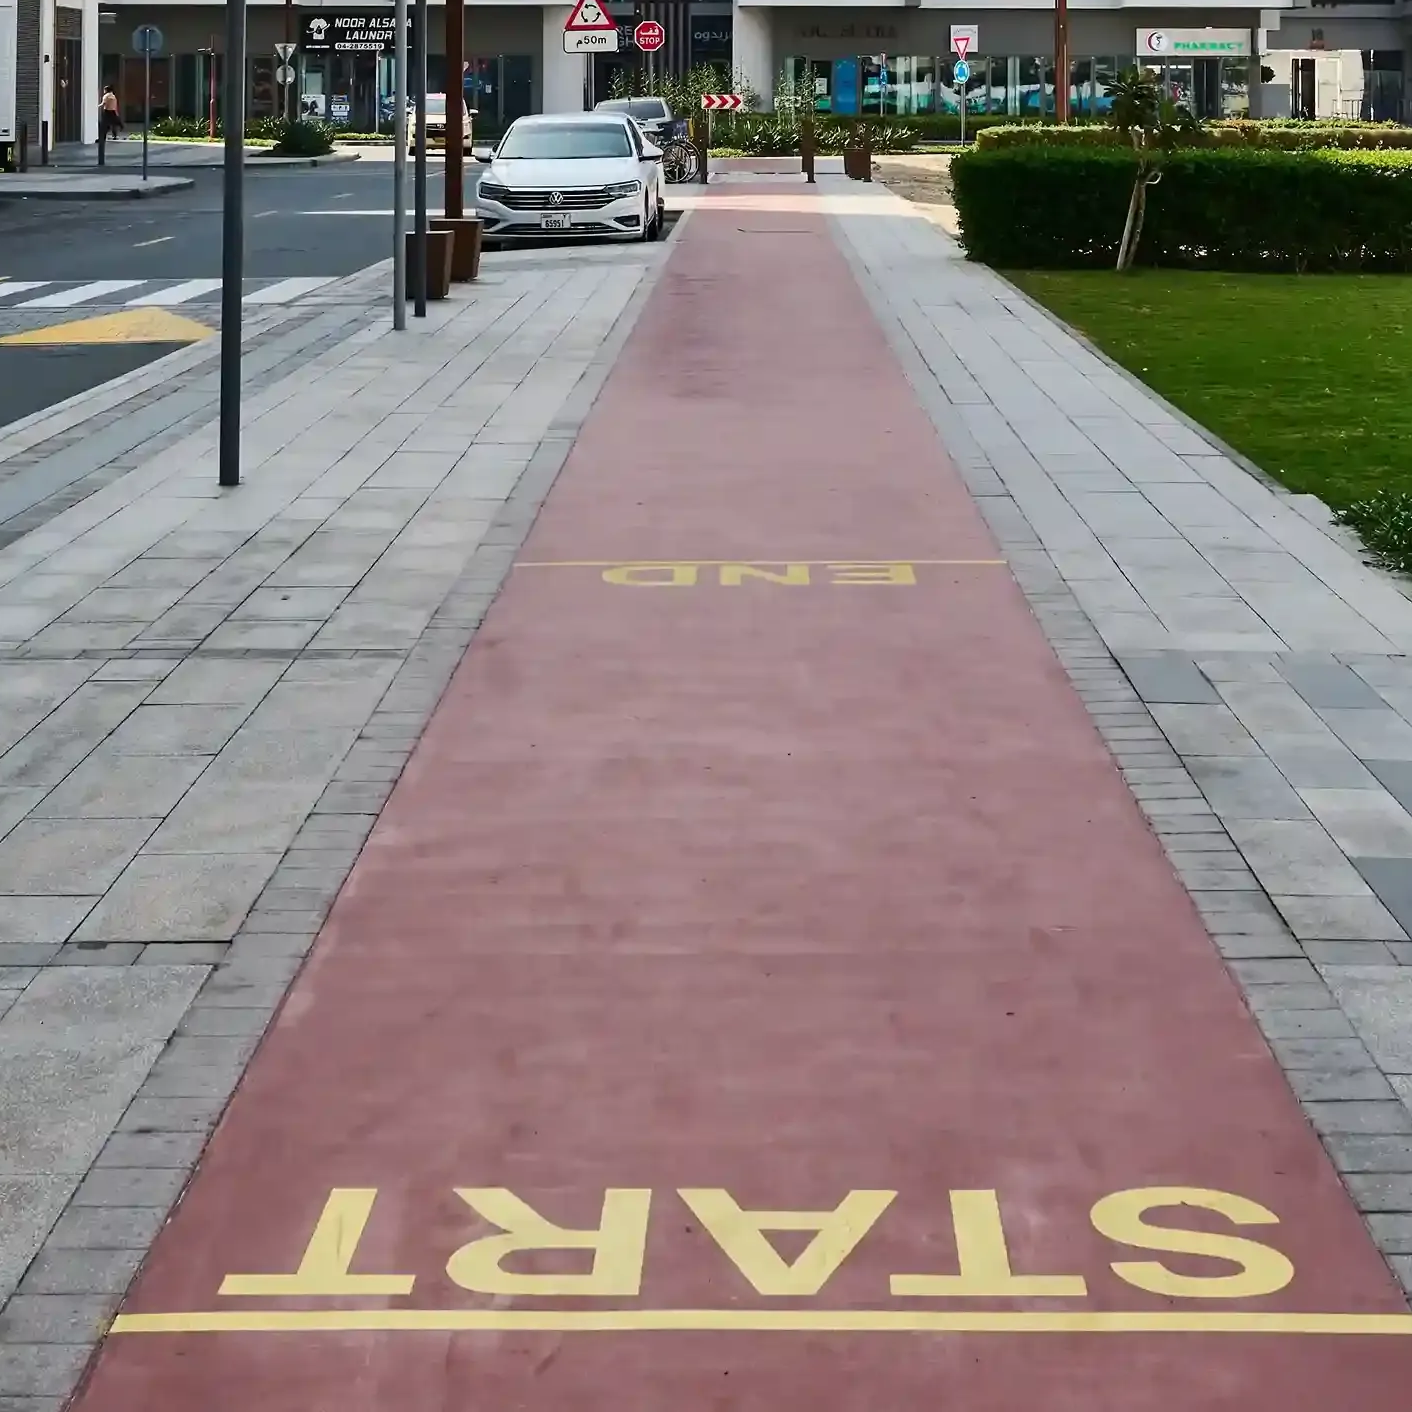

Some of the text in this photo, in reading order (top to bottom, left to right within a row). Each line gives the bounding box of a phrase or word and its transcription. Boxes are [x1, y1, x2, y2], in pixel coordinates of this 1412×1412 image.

[334, 18, 412, 28] NOOR ALSAA
[345, 31, 396, 40] LAUNDR
[639, 37, 660, 45] STOP
[602, 564, 917, 586] END
[216, 1185, 1296, 1299] START
